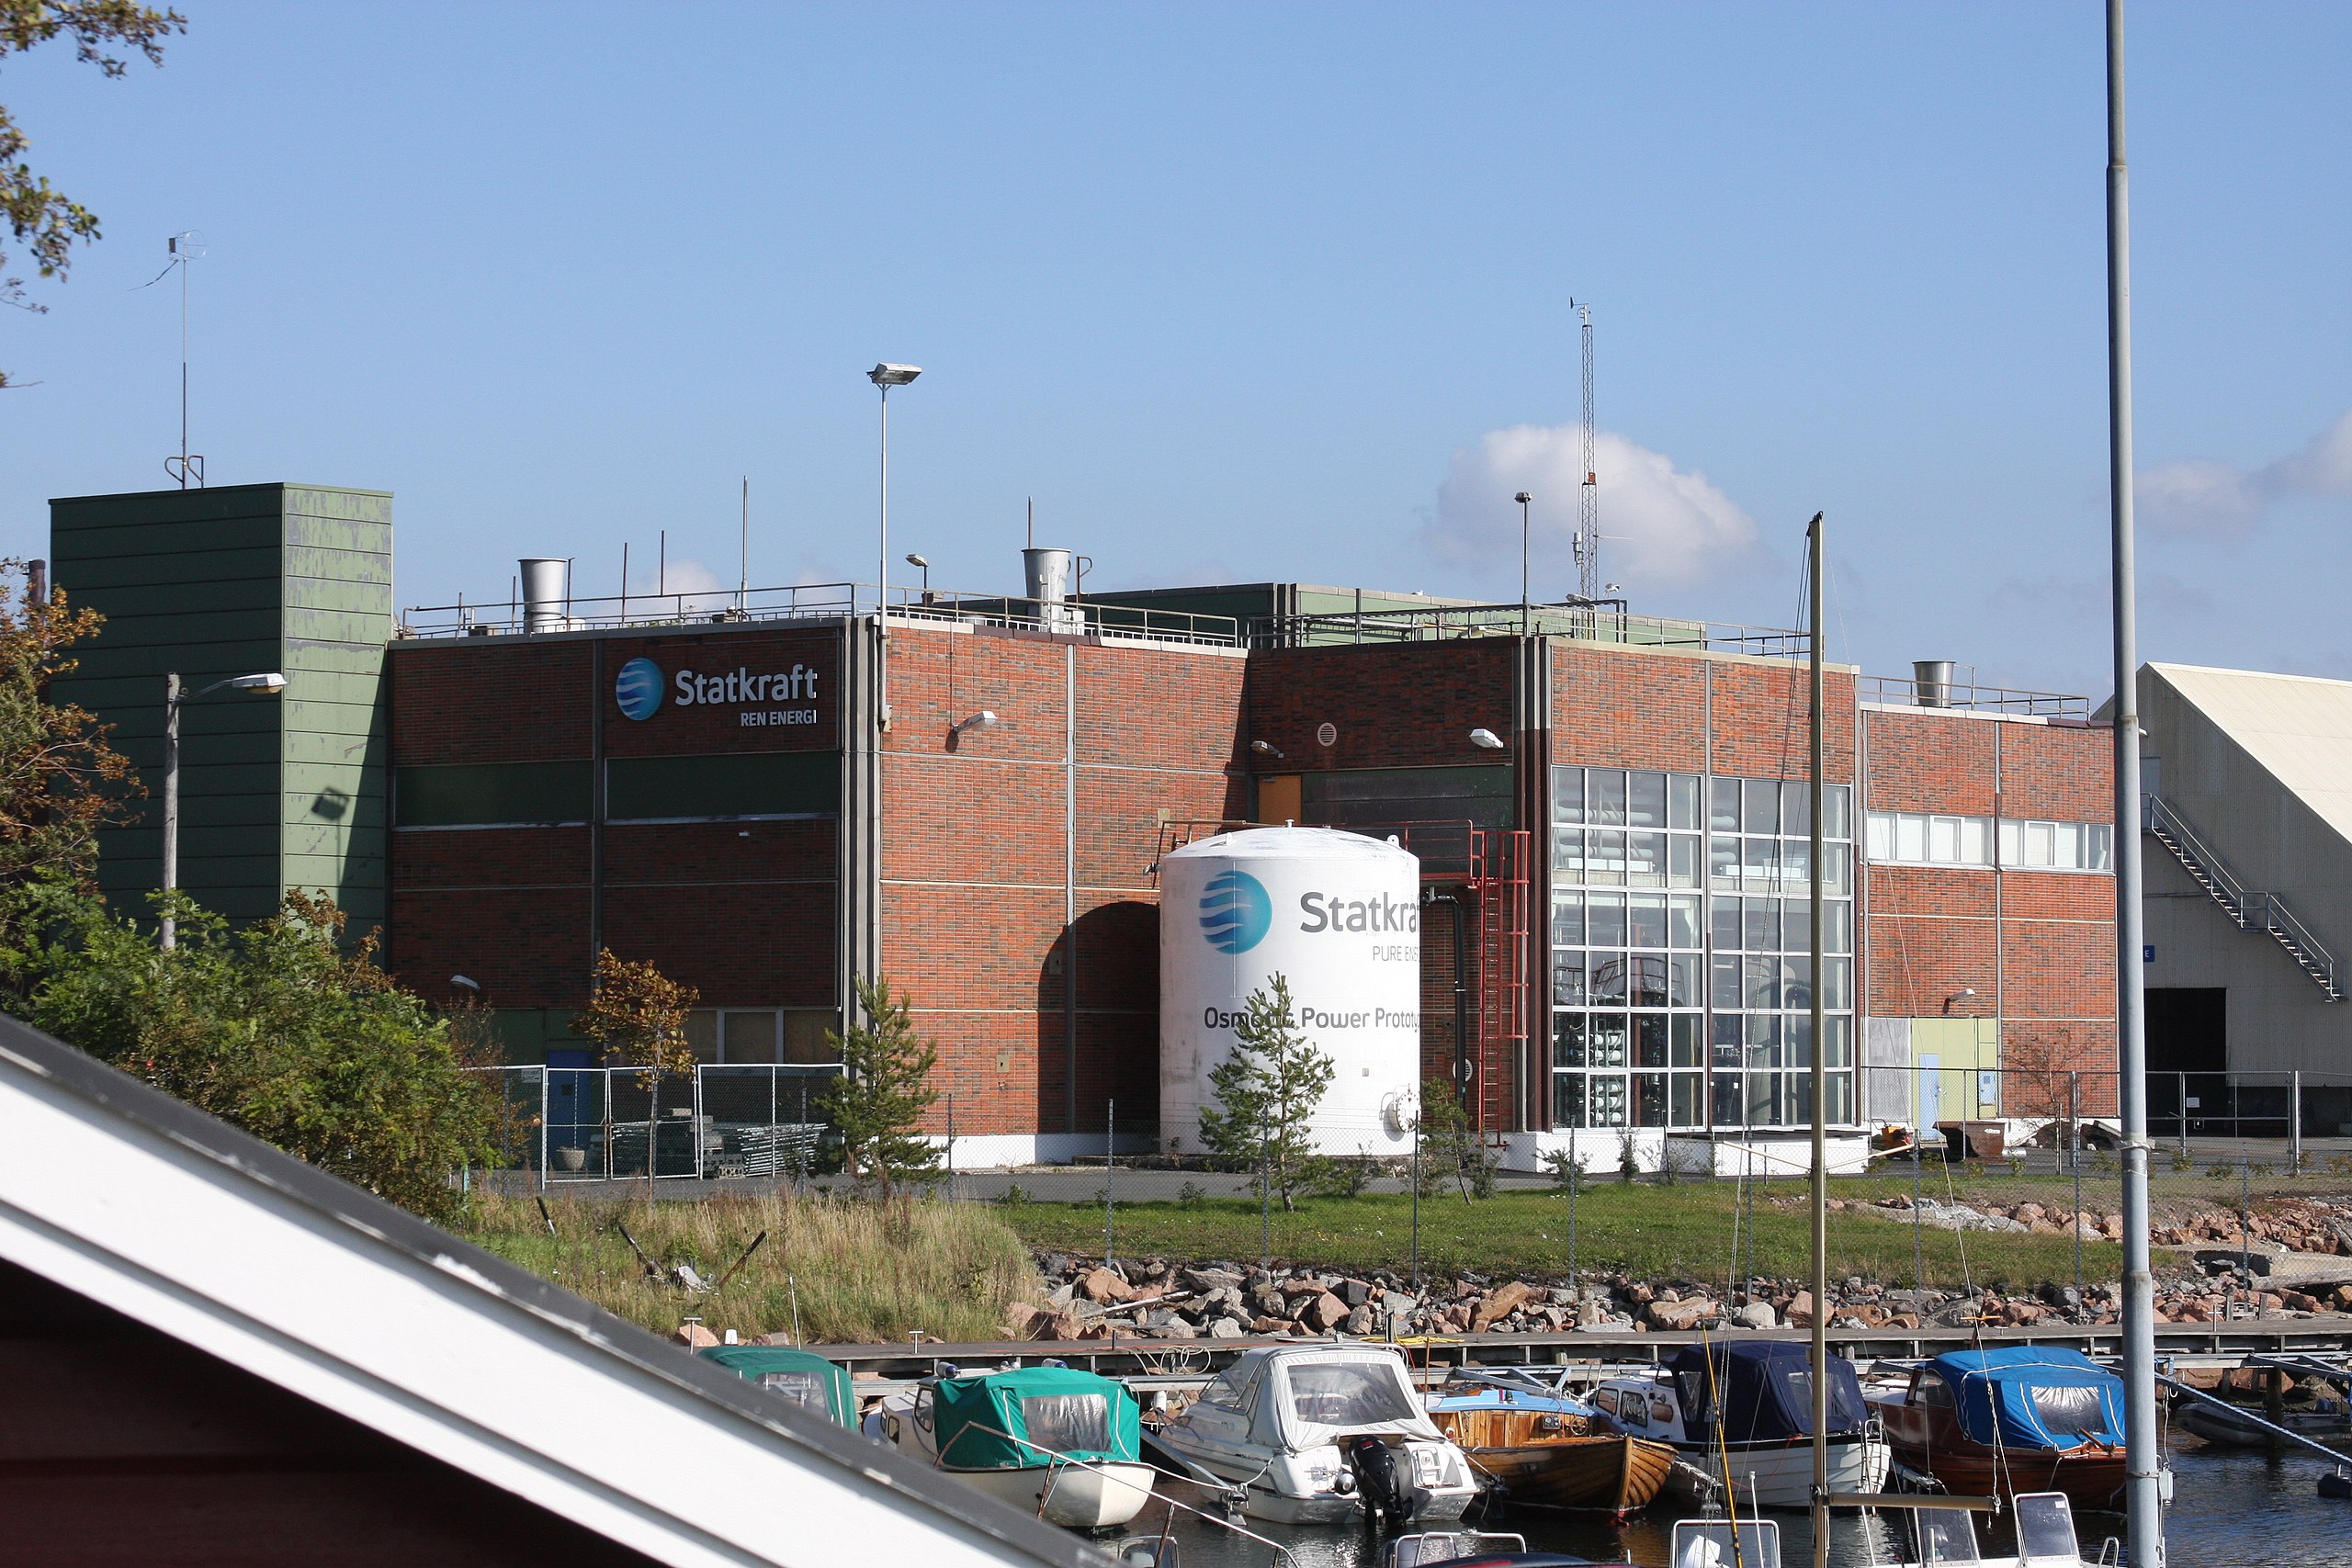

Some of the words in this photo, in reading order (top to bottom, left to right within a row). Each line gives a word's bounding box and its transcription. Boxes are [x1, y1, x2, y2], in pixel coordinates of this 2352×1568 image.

[675, 664, 818, 706] Statkraft
[741, 712, 766, 727] REN
[769, 709, 817, 726] ENERGI
[1373, 945, 1402, 962] PURE
[1301, 1007, 1370, 1029] Power
